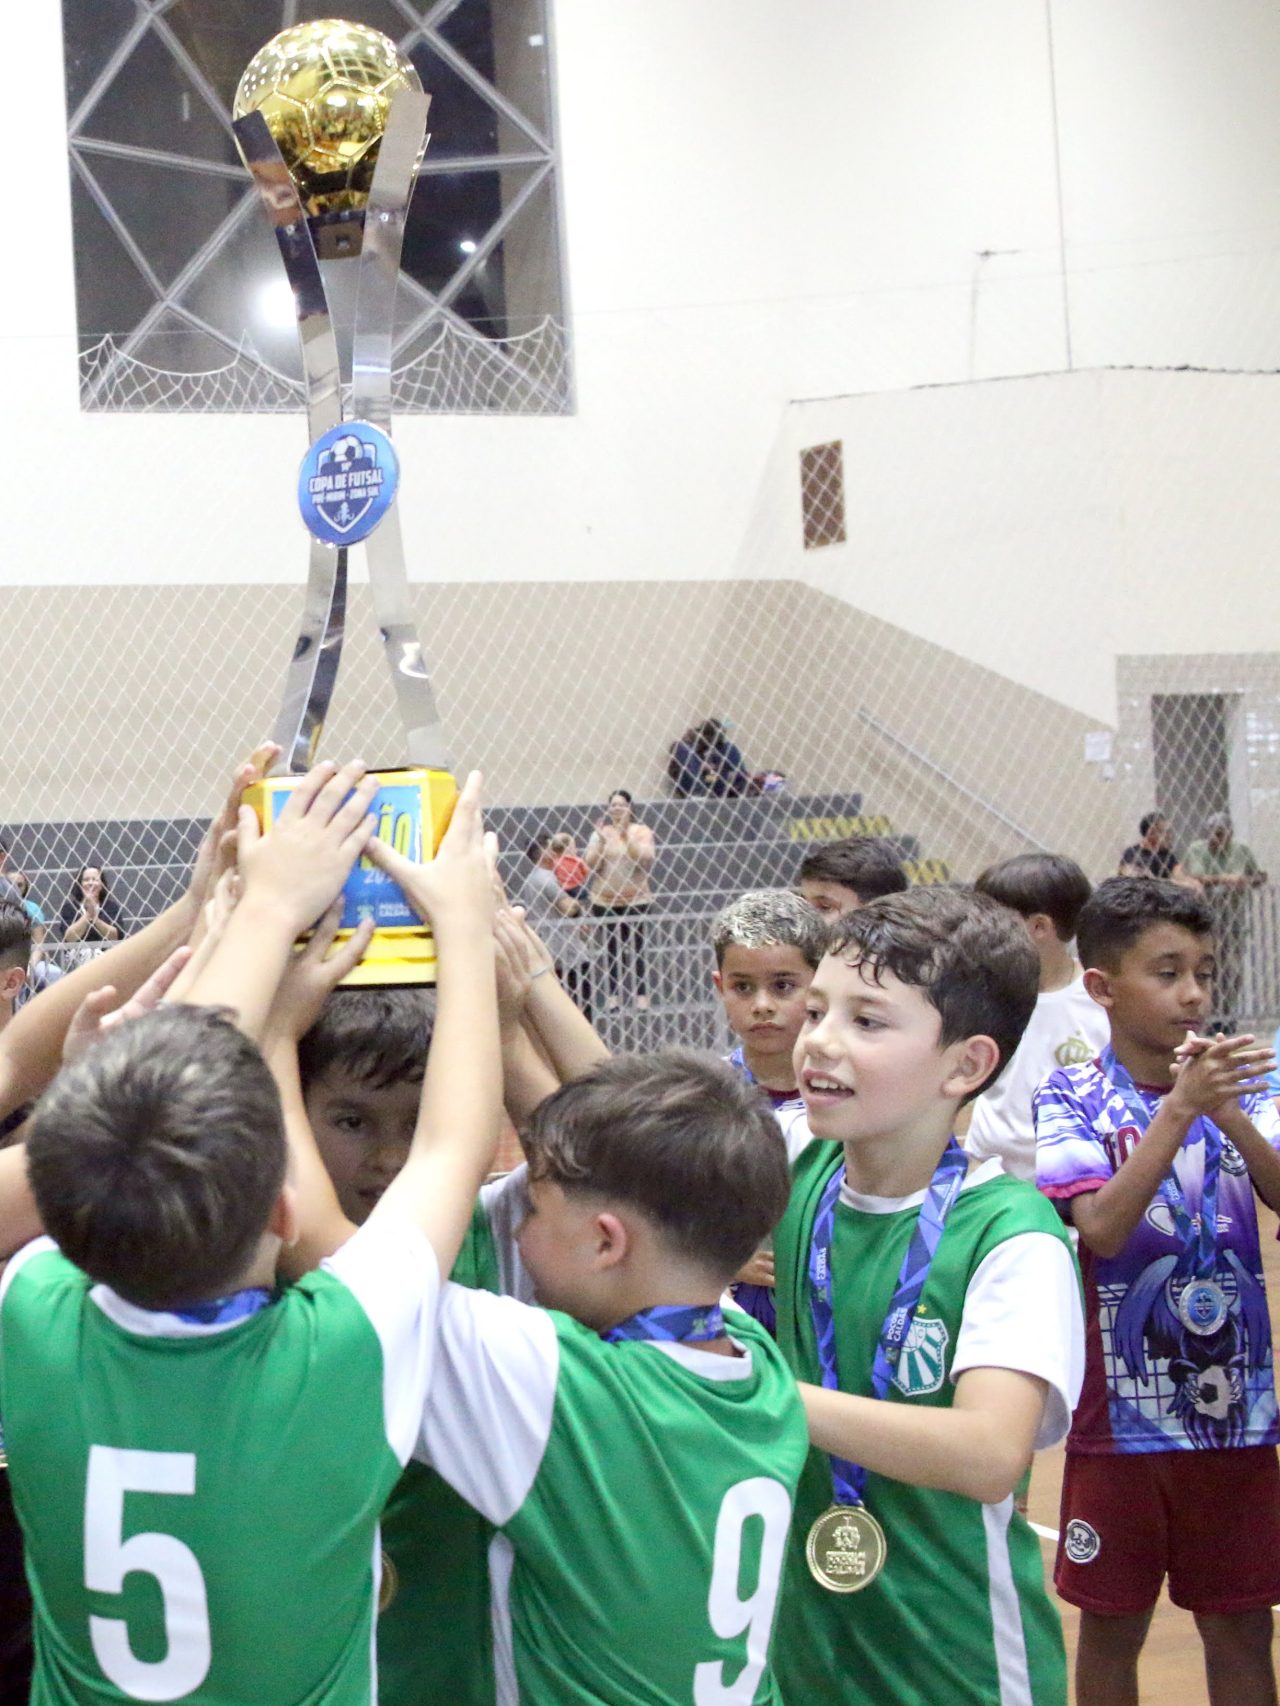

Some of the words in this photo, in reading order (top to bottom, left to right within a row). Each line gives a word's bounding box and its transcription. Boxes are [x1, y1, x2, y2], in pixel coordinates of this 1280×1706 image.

[309, 475, 334, 493] COPA
[334, 473, 348, 489] DE
[348, 468, 384, 488] FUTSAL
[892, 1307, 909, 1342] CALDAS
[83, 1444, 212, 1700] 5
[692, 1475, 793, 1706] 9
